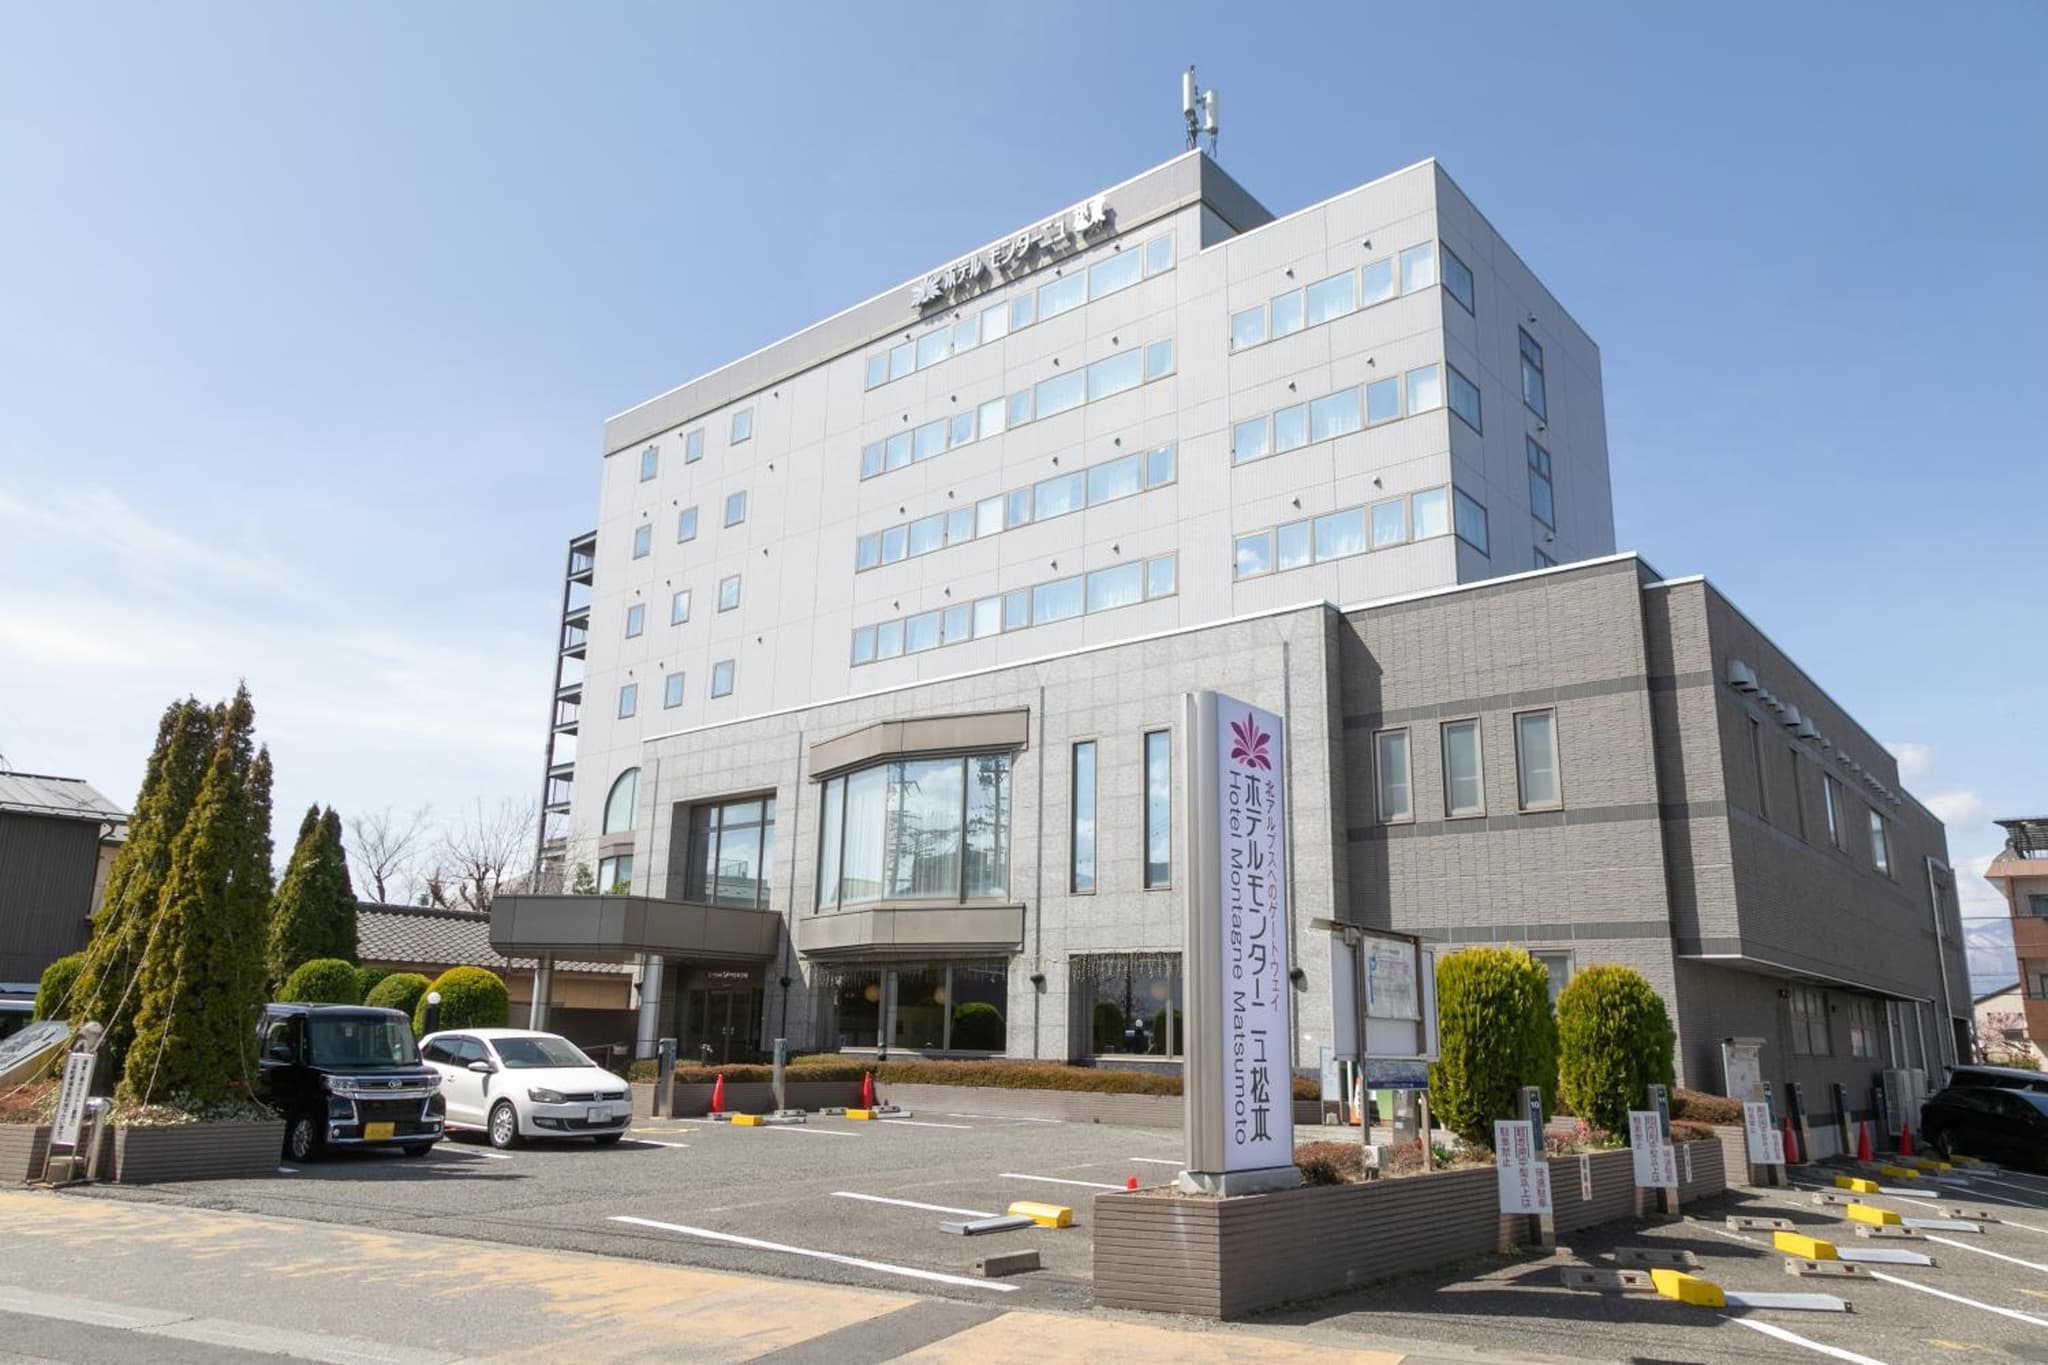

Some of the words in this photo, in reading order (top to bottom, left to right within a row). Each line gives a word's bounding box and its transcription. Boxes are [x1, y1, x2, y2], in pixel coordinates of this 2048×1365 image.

[943, 257, 981, 289] ホテル
[1229, 769, 1243, 841] Hotel
[1230, 847, 1244, 980] Montagne
[1244, 774, 1273, 1143] ホテルモンターニュ松本
[1233, 990, 1248, 1146] Matsumoto
